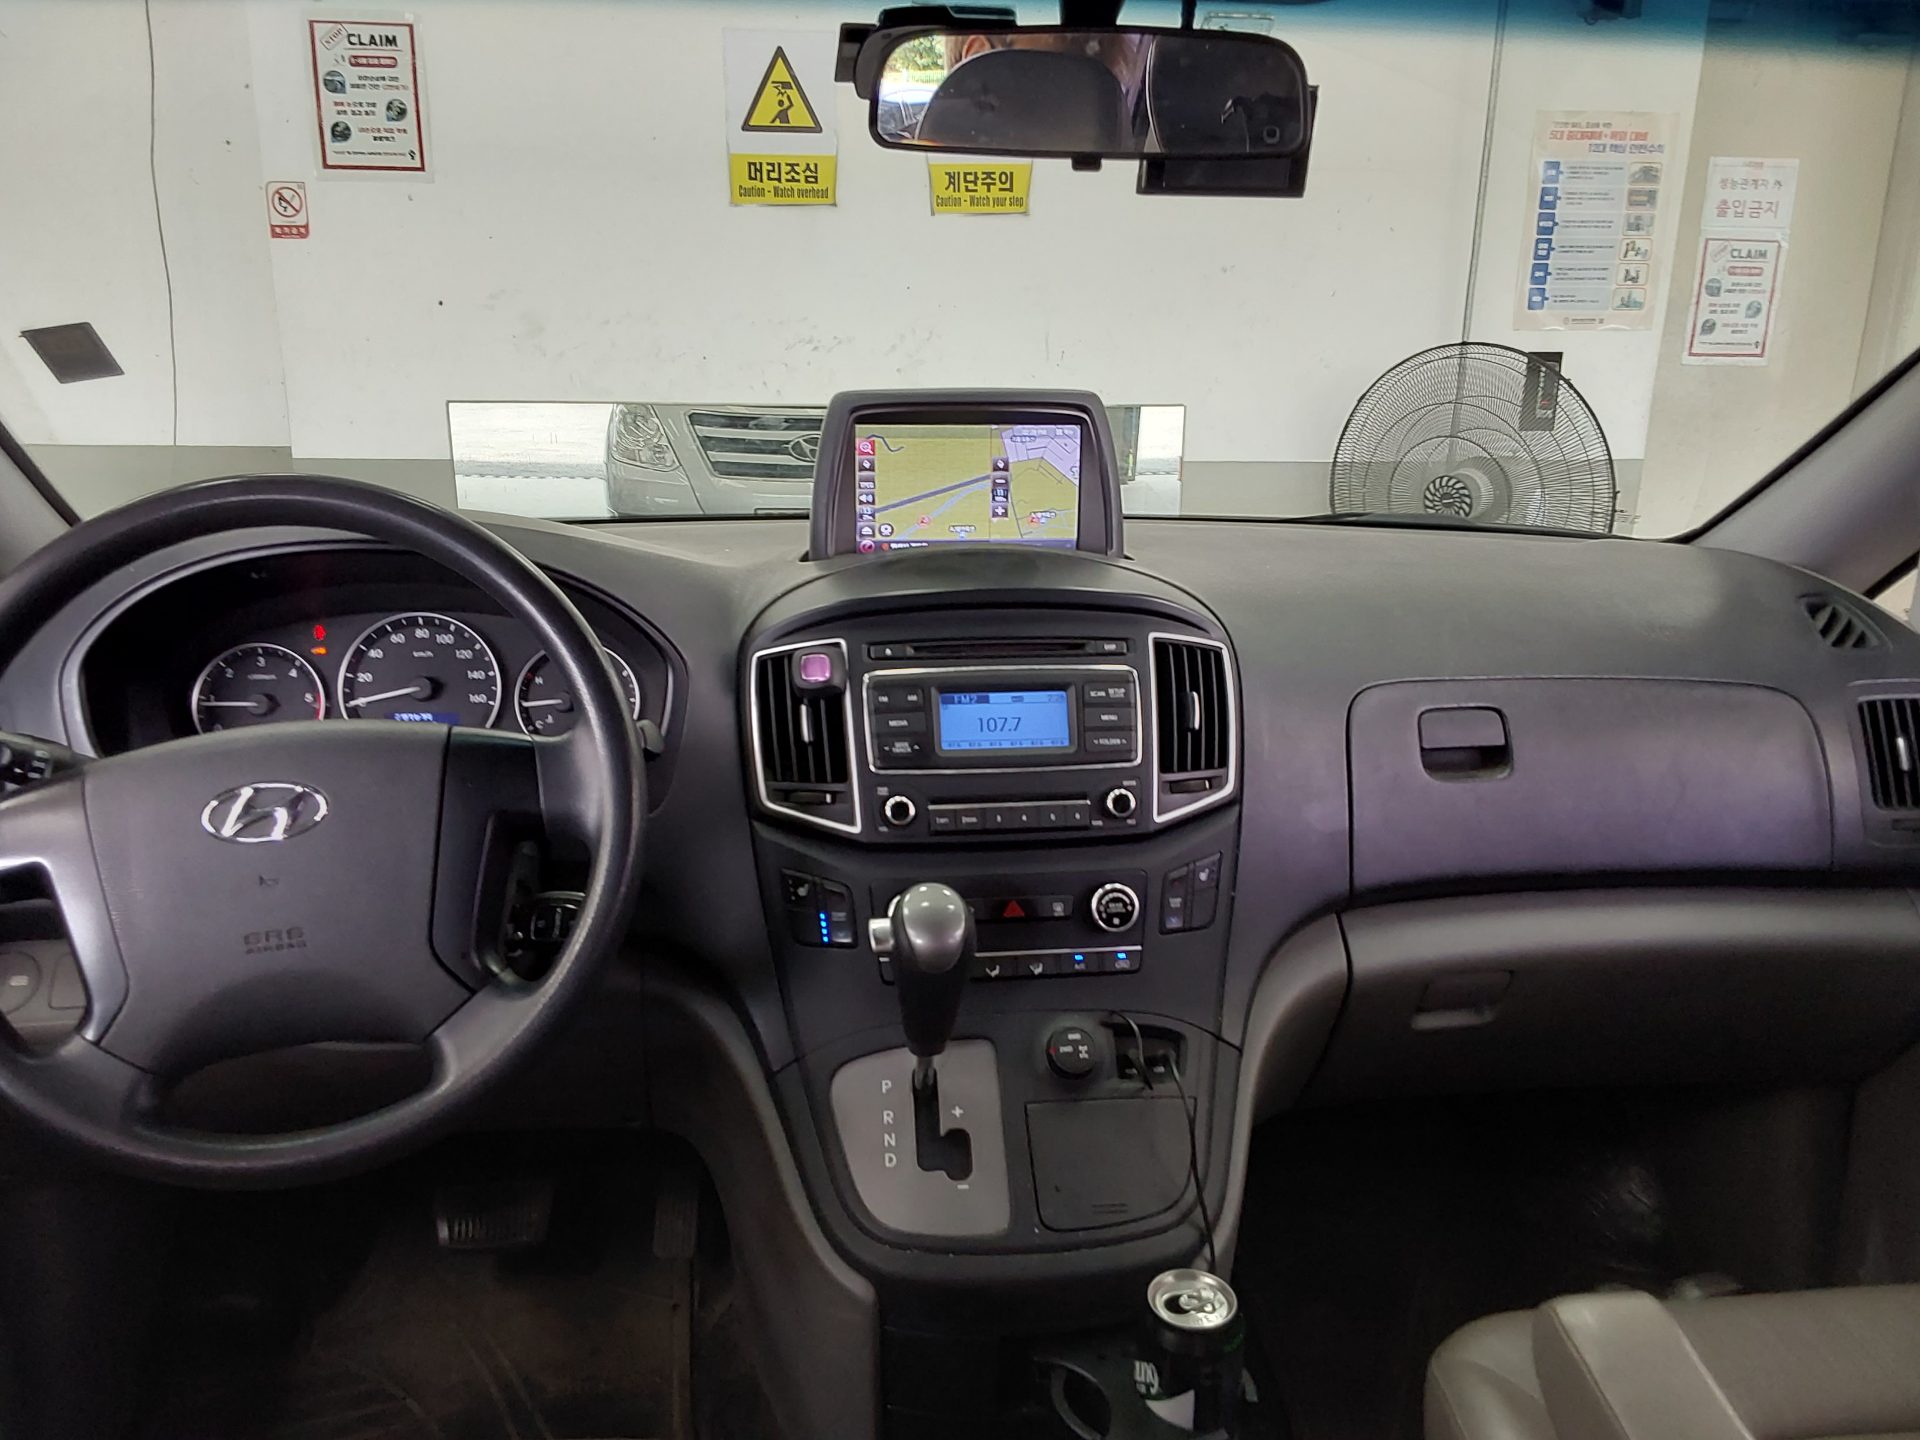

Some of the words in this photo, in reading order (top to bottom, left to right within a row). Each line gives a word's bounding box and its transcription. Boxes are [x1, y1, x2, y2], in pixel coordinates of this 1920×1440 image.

[347, 33, 398, 48] CLAIM
[747, 161, 819, 185] 머리조심
[944, 171, 1014, 193] 계단주의
[738, 184, 766, 198] Caution
[773, 185, 795, 199] Watch
[796, 186, 829, 199] overhead
[935, 194, 962, 208] Caution
[969, 194, 990, 207] Watch
[992, 196, 1007, 208] your
[1008, 195, 1024, 208] step
[1716, 199, 1779, 219] 출입금지
[1730, 248, 1768, 260] CLAIM
[435, 633, 455, 645] 100
[368, 648, 384, 659] 40
[455, 649, 473, 660] 120
[357, 672, 373, 683] 20
[467, 670, 485, 680] 140
[468, 693, 487, 704] 160
[977, 717, 1021, 733] 107.7
[881, 1079, 892, 1094] P
[882, 1109, 894, 1125] R
[883, 1132, 896, 1148] N
[884, 1152, 897, 1168] D
